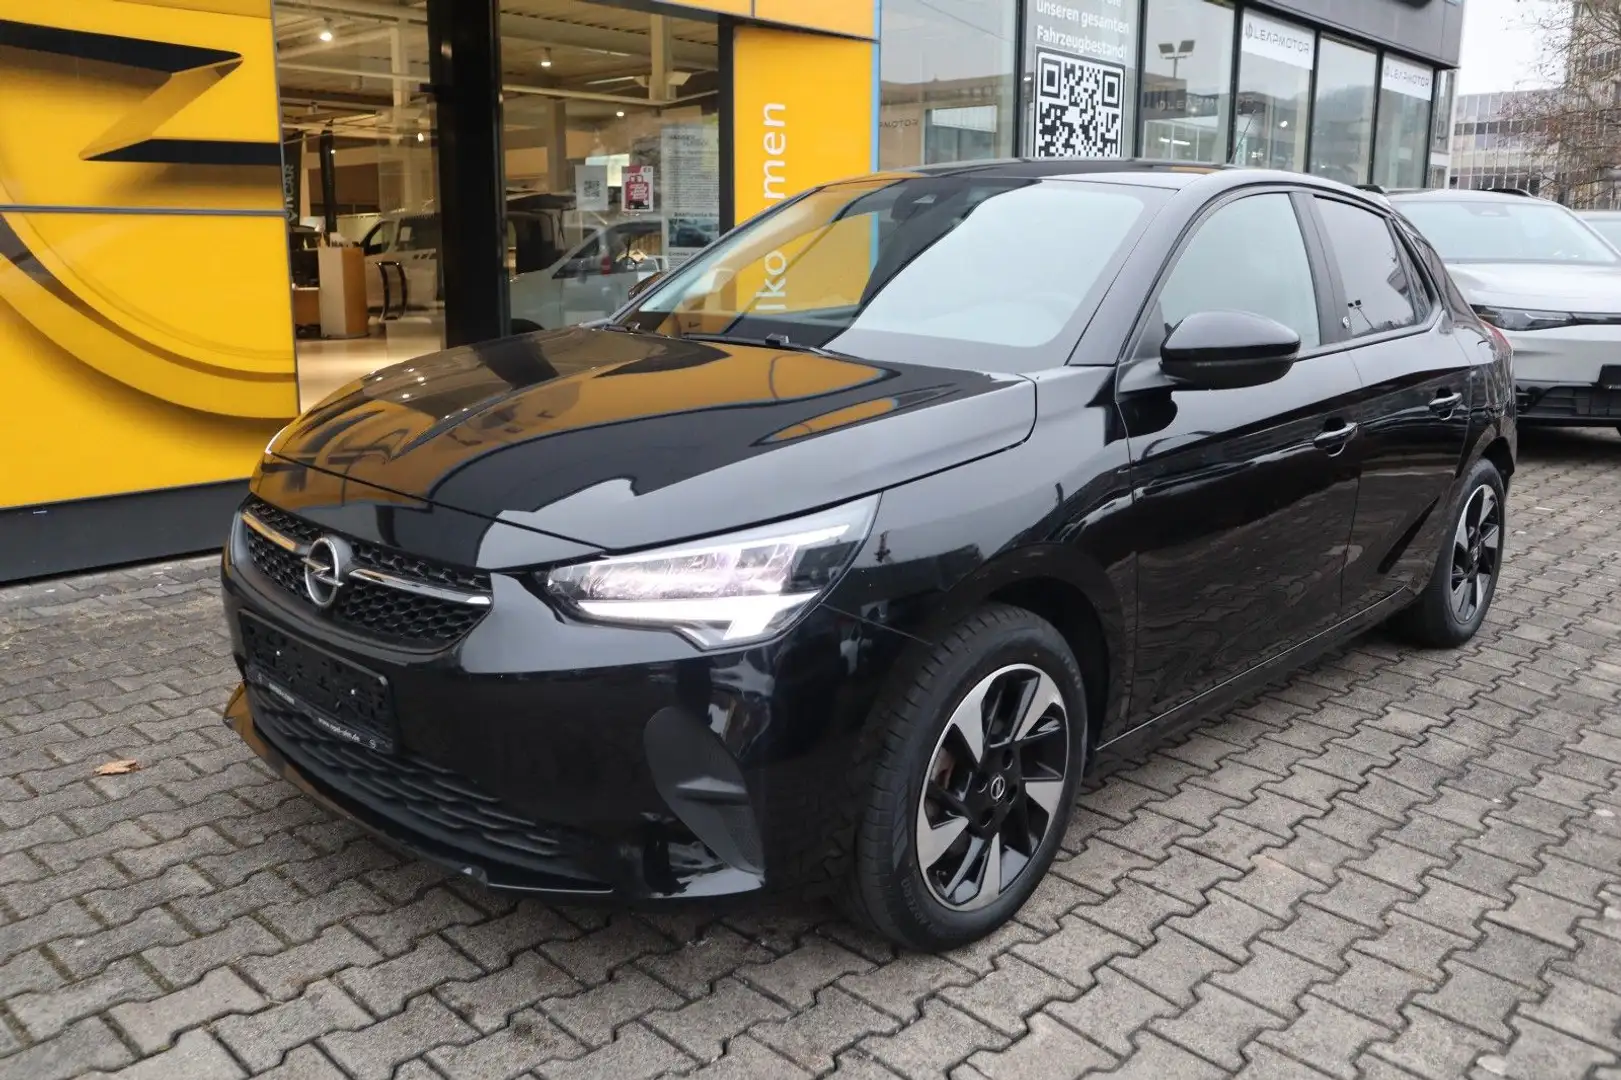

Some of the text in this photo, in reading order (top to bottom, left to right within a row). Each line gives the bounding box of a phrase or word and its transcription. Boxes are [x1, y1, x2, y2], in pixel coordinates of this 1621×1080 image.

[1036, 0, 1130, 34] unseren gesamten
[1036, 25, 1127, 59] Fahrzeugbestand!
[1254, 29, 1310, 53] LEAPMOTOR
